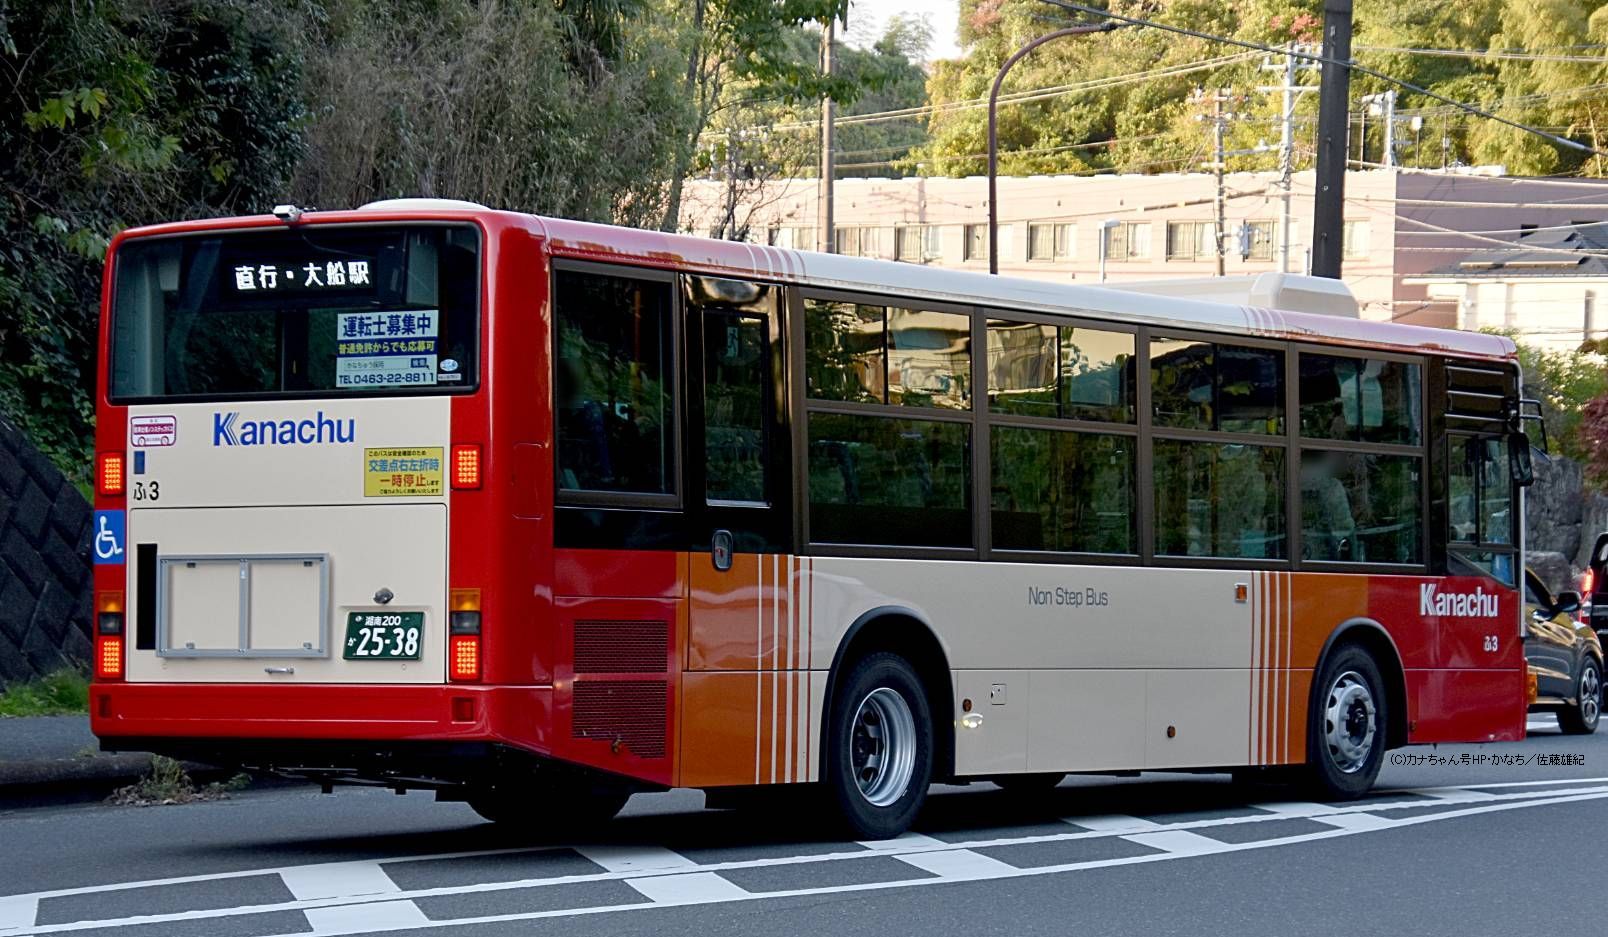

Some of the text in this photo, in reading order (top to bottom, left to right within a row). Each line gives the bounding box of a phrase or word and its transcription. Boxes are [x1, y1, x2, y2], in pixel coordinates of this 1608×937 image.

[235, 260, 370, 291] 直行・大船駅
[343, 313, 431, 338] 運転士募集中
[339, 341, 435, 355] 普通免許からでも応募可
[339, 374, 352, 384] TEL
[354, 372, 434, 384] 0463-22-8811
[213, 411, 355, 446] Kanachu
[368, 458, 439, 472] 交差点右左折時
[133, 481, 159, 501] ふ3
[1028, 587, 1109, 608] Non Step Bus
[1420, 583, 1498, 617] Kanachu
[365, 615, 402, 626] 湘南200
[356, 627, 419, 656] 25-38
[1483, 635, 1498, 652] ふ3
